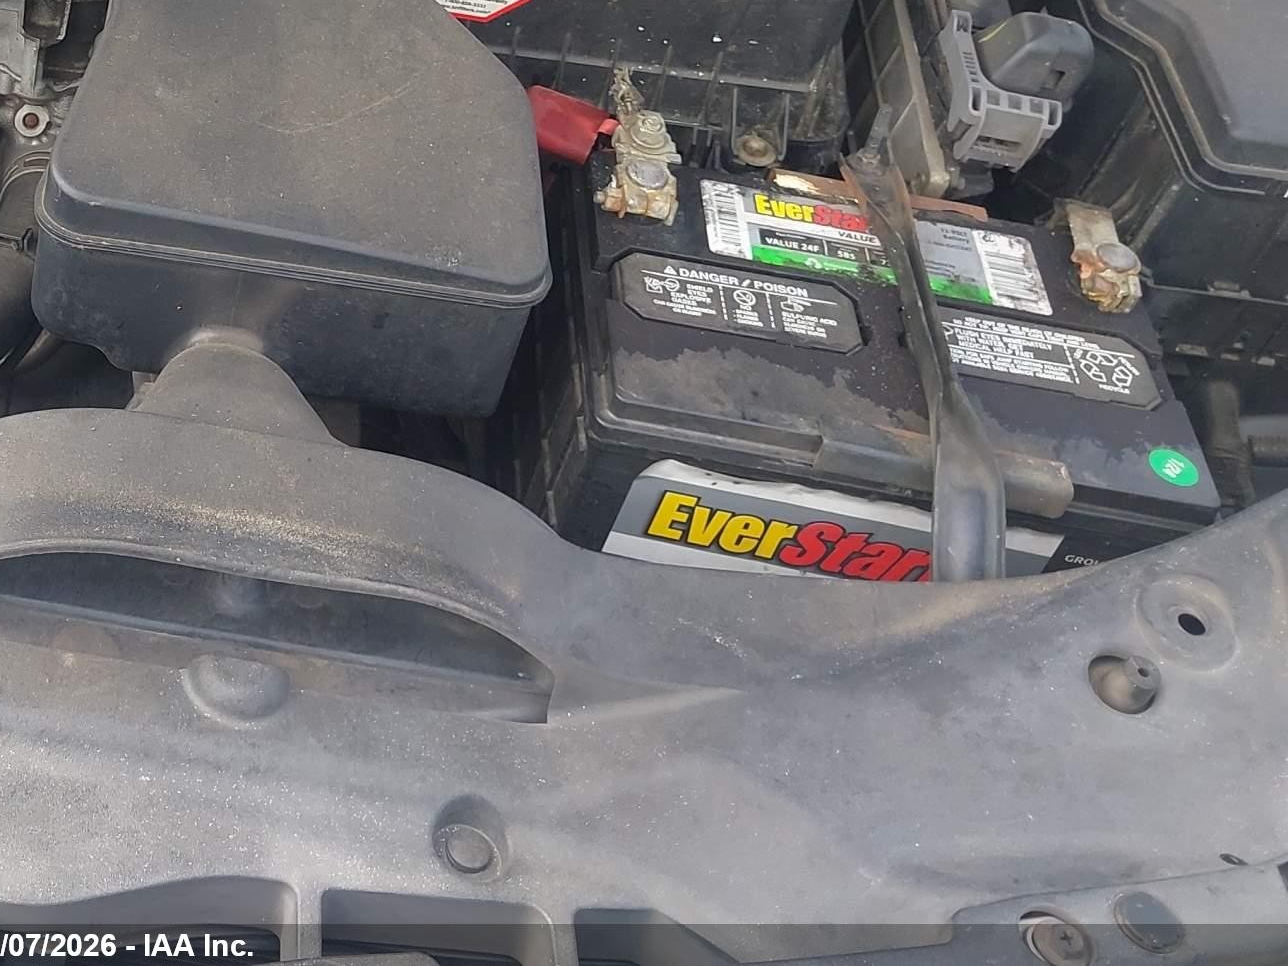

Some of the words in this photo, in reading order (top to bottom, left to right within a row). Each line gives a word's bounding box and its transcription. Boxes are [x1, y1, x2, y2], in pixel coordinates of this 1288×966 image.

[753, 193, 870, 232] EverStar
[765, 236, 798, 249] VALUE
[801, 242, 820, 253] 24F
[838, 231, 876, 243] VALUE
[679, 268, 739, 285] DANGER
[754, 280, 809, 298] POISON
[646, 489, 931, 583] EverStar
